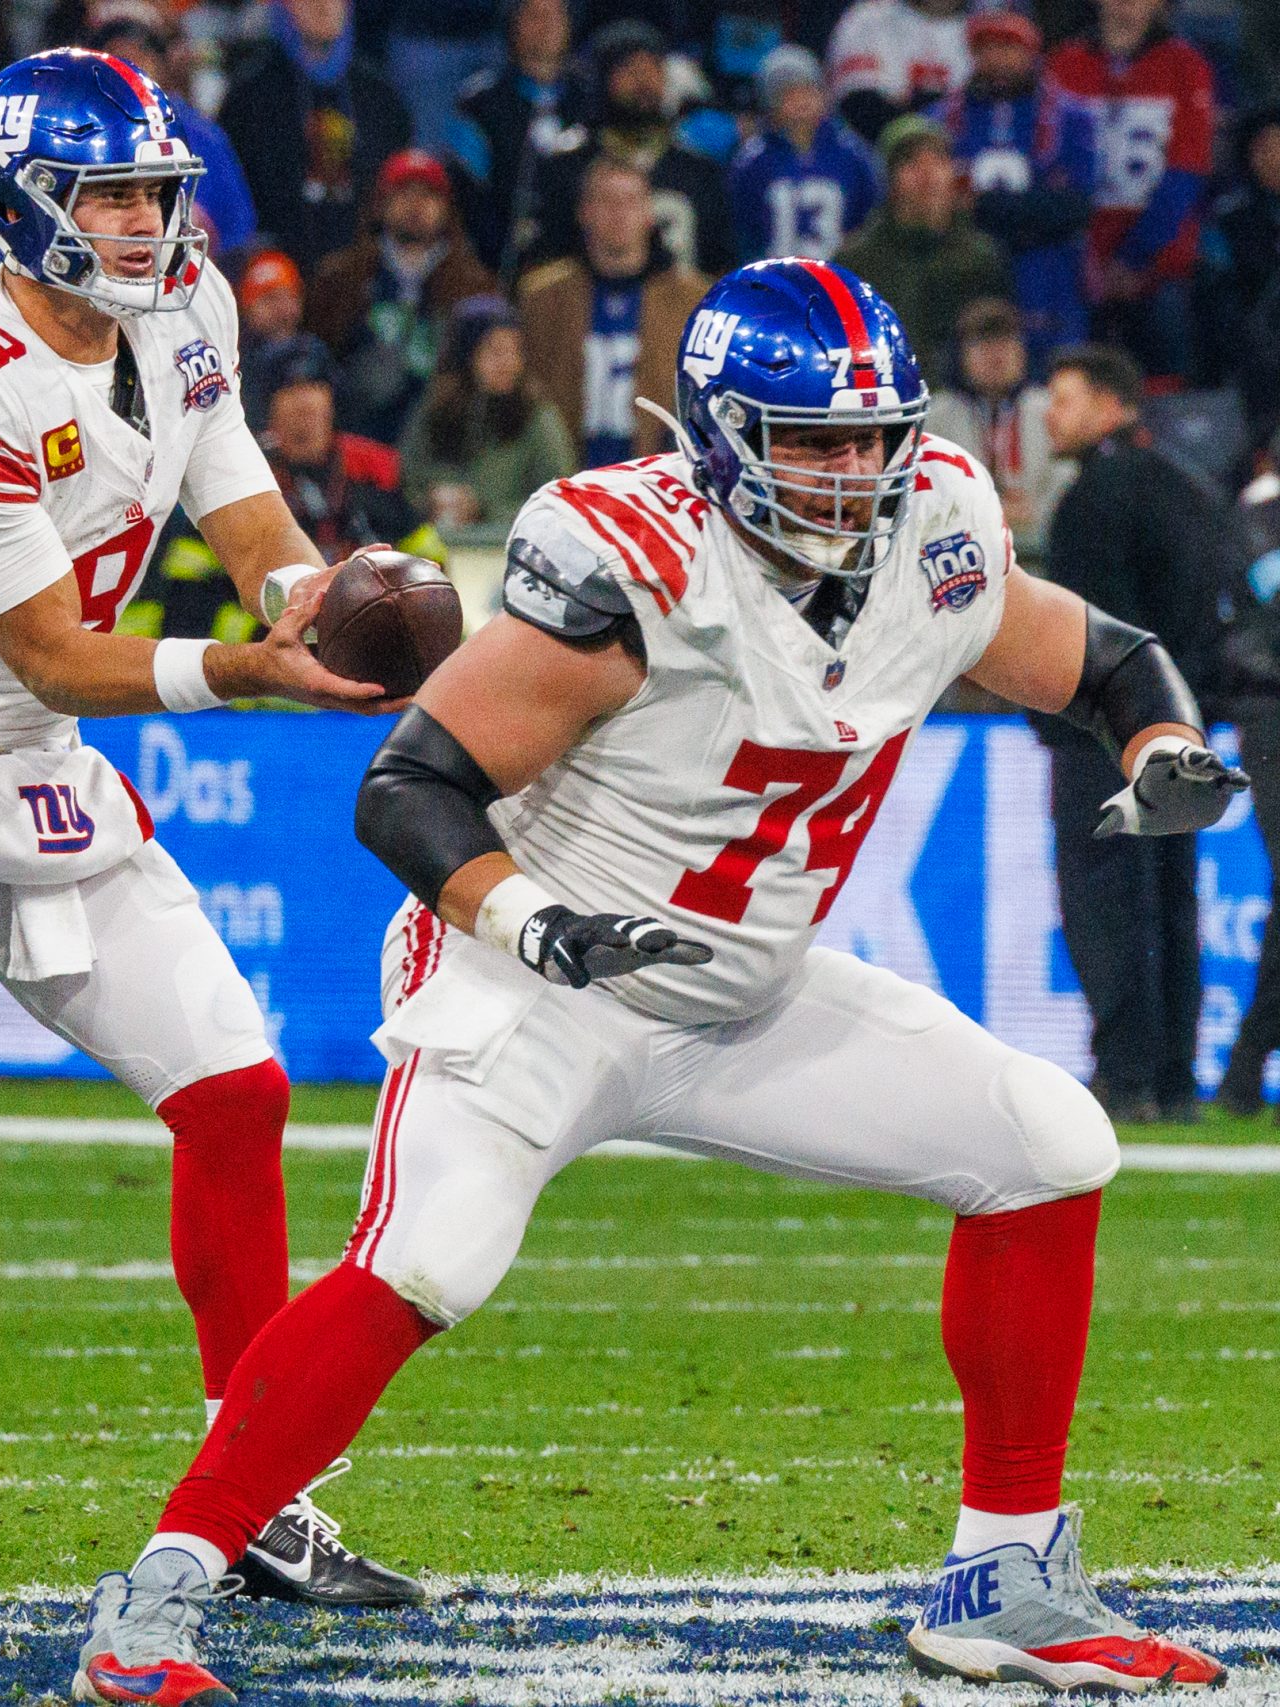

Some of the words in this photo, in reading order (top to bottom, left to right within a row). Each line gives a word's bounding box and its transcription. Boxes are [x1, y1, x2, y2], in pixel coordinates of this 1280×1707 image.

[144, 105, 168, 140] 8
[178, 345, 222, 394] 100
[45, 424, 81, 468] C
[922, 540, 985, 586] 100
[138, 721, 256, 826] Das
[668, 726, 912, 927] 74
